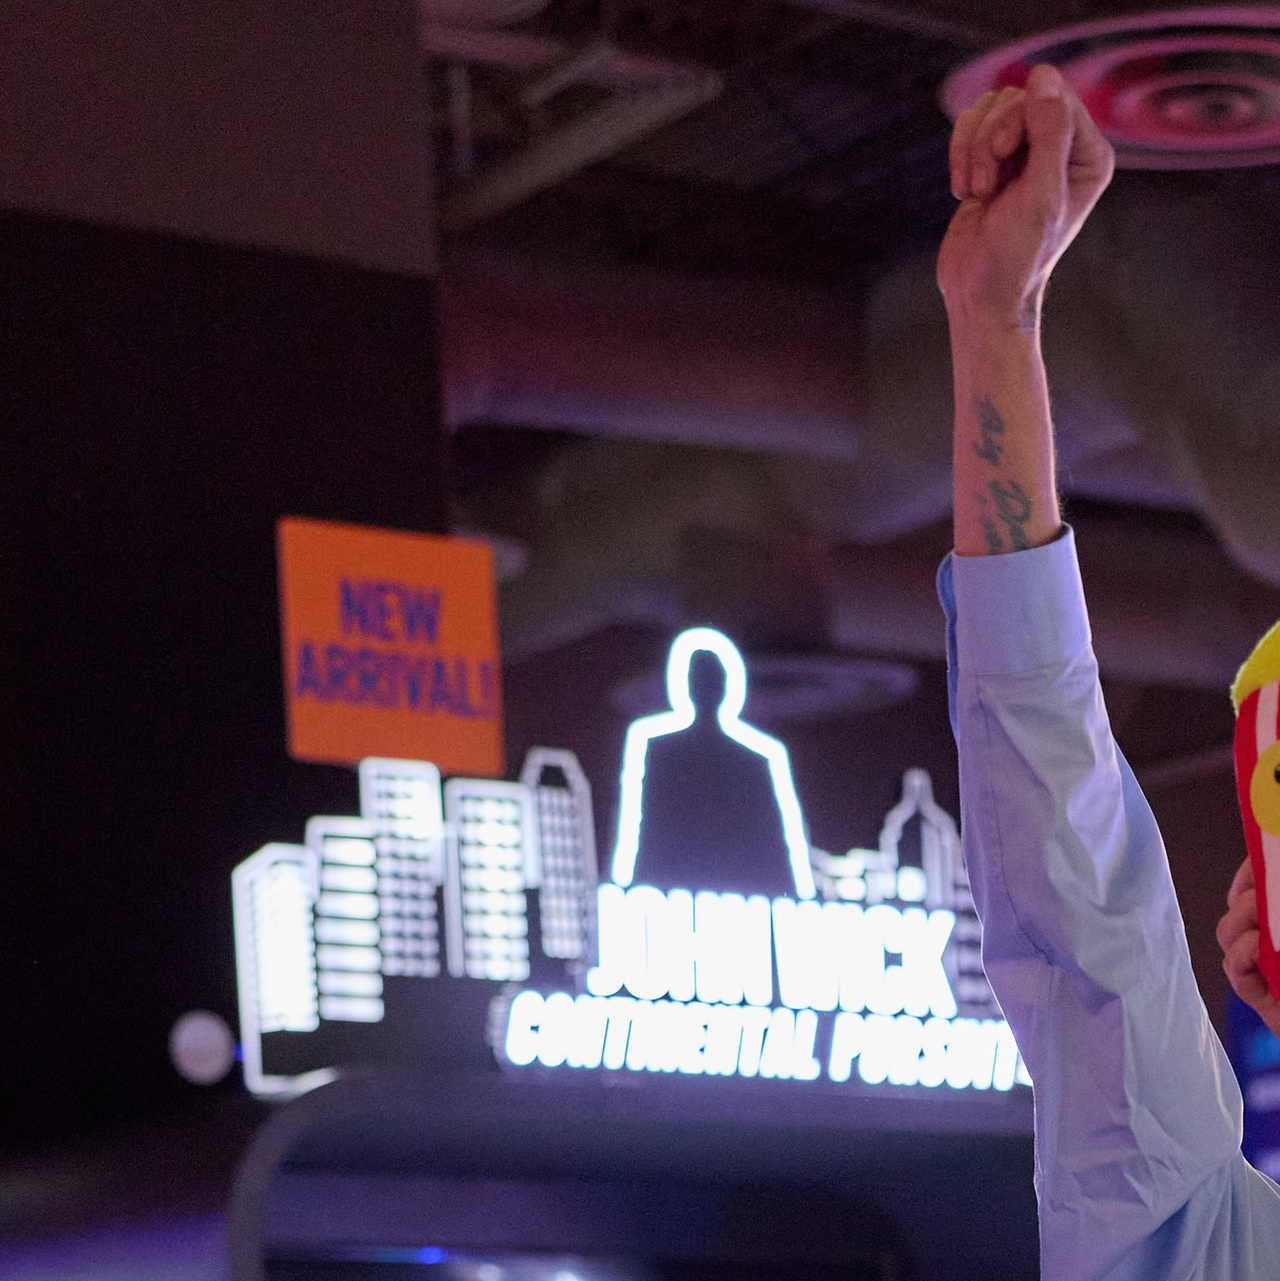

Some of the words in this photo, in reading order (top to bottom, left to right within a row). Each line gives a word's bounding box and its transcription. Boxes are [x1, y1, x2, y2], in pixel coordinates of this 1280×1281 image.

[338, 576, 442, 644] NEW
[296, 643, 496, 722] ARRIVAL!
[586, 883, 773, 1006] JOHN
[770, 897, 958, 1020] WICK
